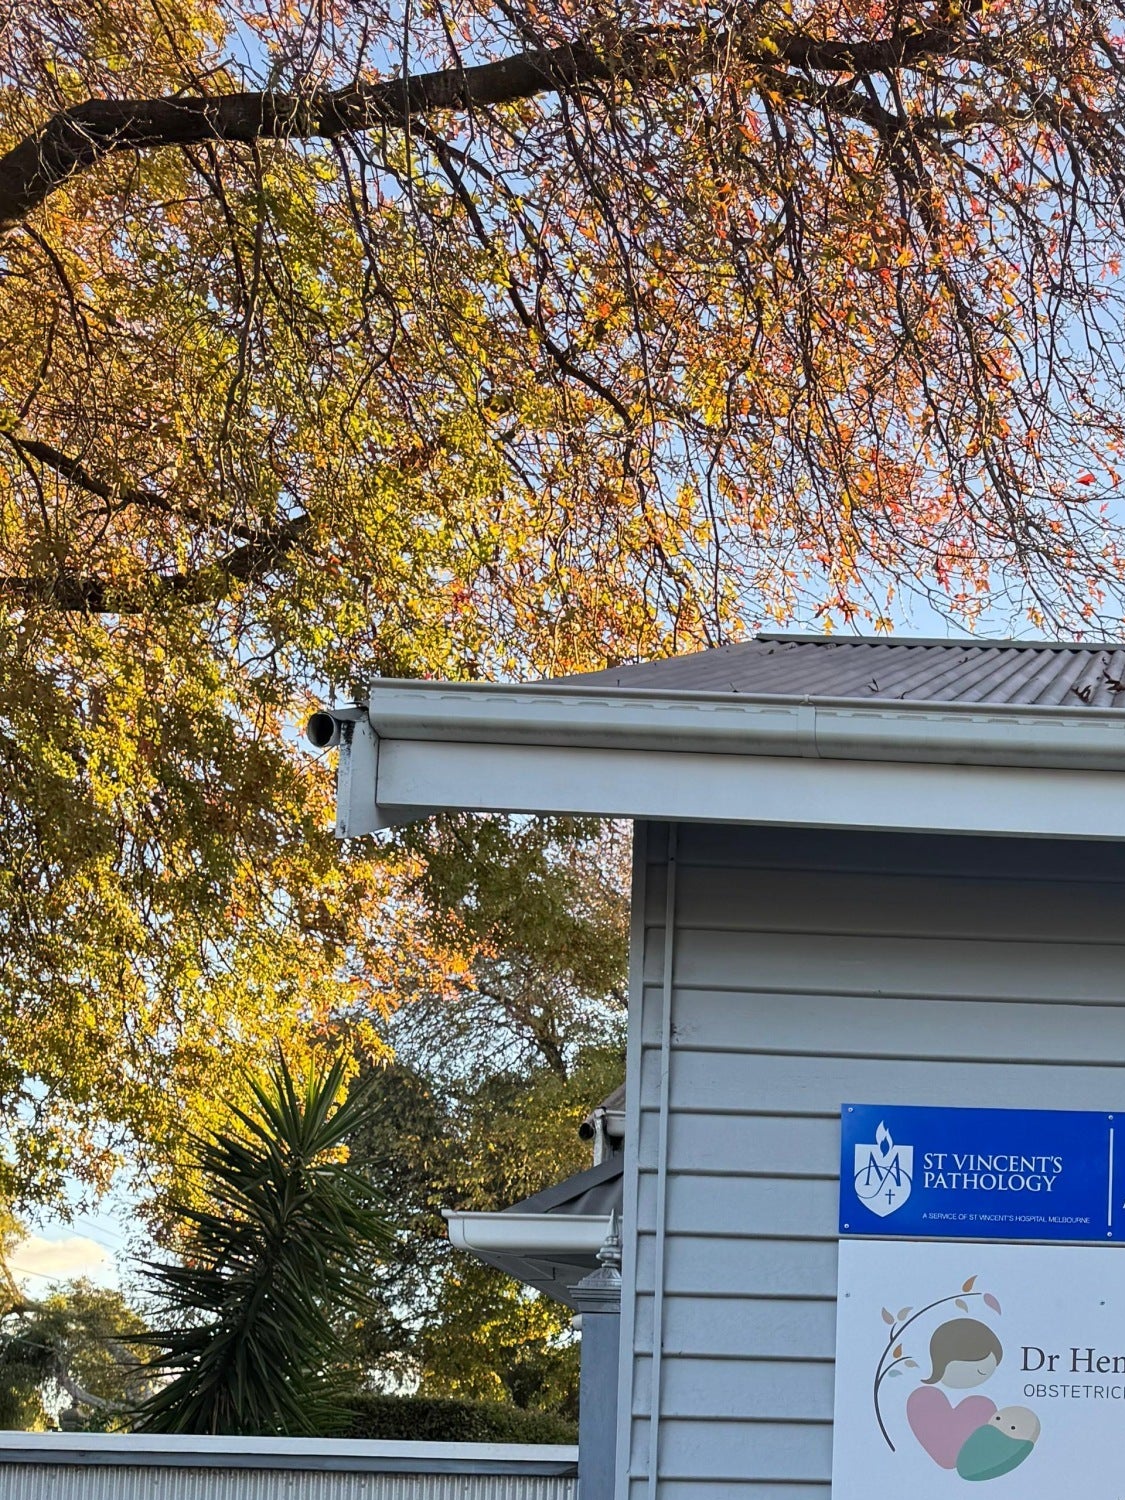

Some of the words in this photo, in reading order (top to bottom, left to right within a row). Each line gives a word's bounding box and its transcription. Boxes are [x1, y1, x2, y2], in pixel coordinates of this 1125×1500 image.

[923, 1153, 947, 1170] ST
[952, 1154, 1063, 1174] VINCENT'S
[923, 1172, 1057, 1192] PATHOLOGY
[928, 1212, 957, 1221] SERVICE
[958, 1213, 968, 1221] OF
[968, 1213, 978, 1221] ST
[979, 1214, 1014, 1222] VINCENT'S
[1015, 1215, 1047, 1223] HOSPITAL
[1048, 1215, 1091, 1224] MELBOURNE
[1020, 1346, 1060, 1372] Dr
